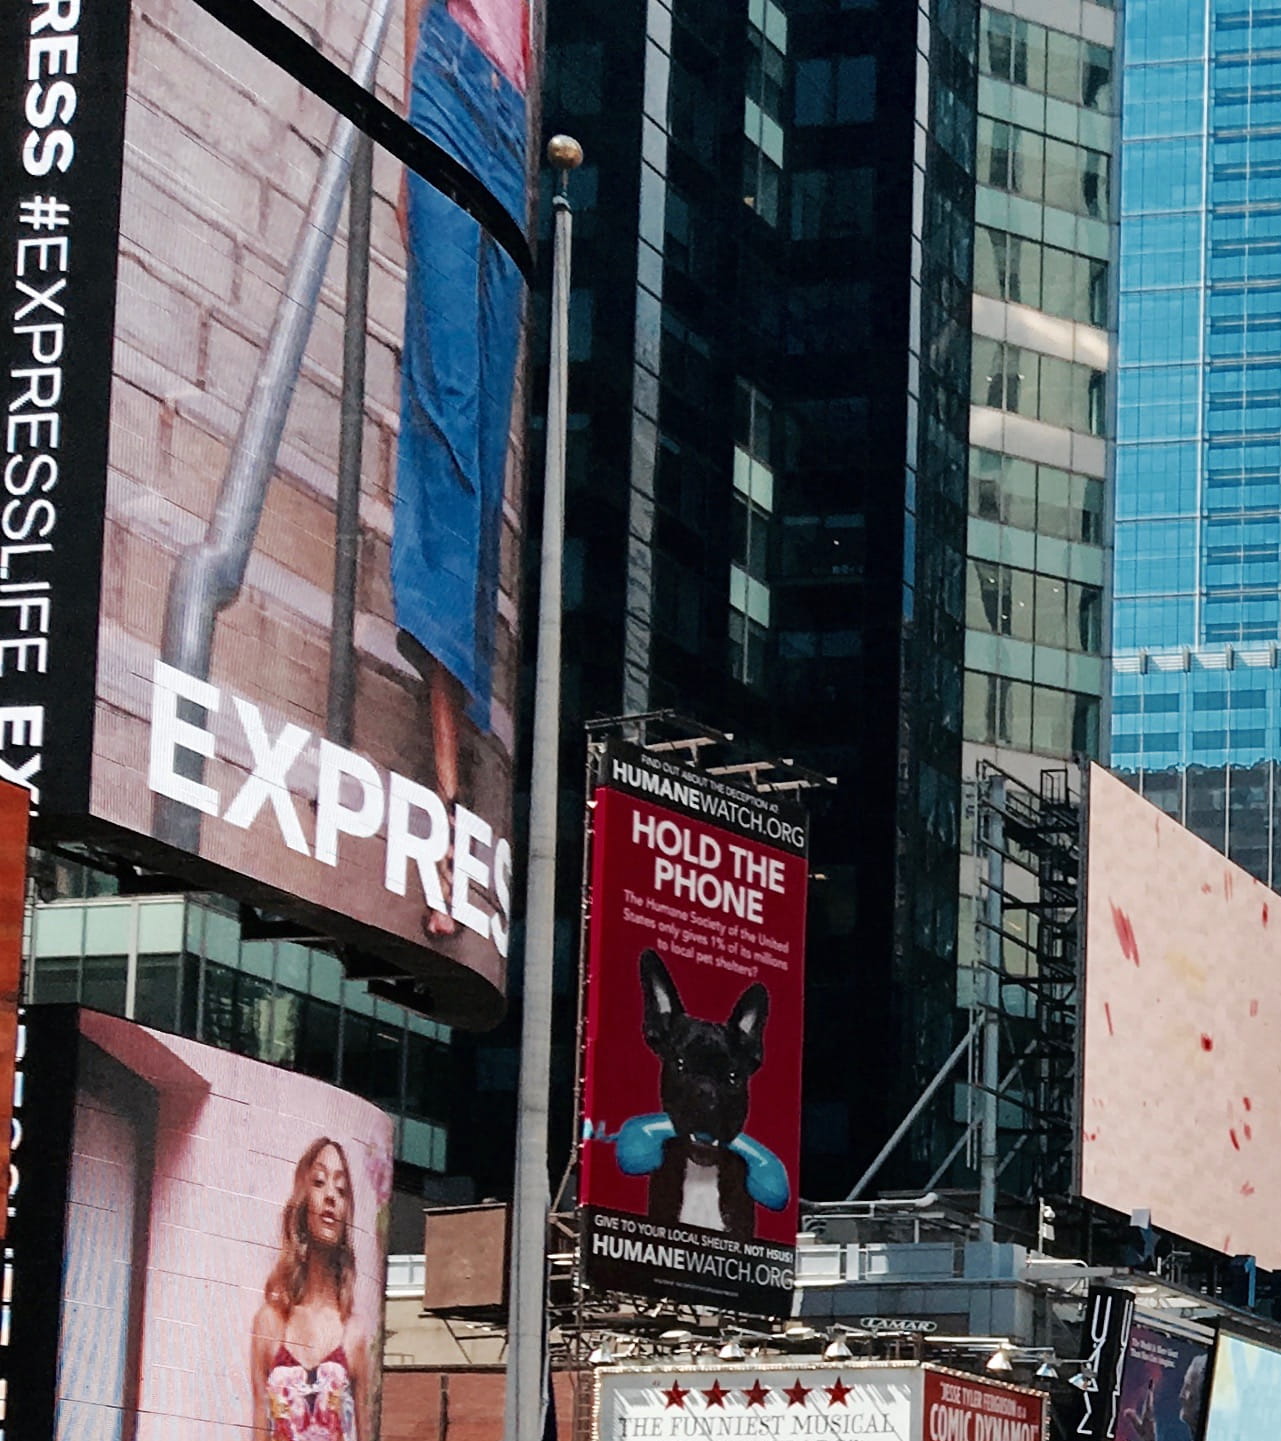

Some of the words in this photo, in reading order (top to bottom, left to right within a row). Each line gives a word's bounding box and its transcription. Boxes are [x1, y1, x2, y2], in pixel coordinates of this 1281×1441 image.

[612, 759, 805, 848] HUMANEWATCH.ORG
[632, 810, 721, 869] HOLD
[728, 843, 785, 894] THE
[654, 856, 764, 925] PHONE
[623, 889, 643, 907] The
[646, 898, 688, 923] Humane
[690, 910, 726, 937] Society
[728, 919, 740, 936] of
[758, 931, 790, 954] United
[623, 908, 656, 931] States
[658, 918, 681, 941] only
[682, 929, 708, 947] gives
[754, 947, 788, 971] millions
[657, 938, 668, 951] to
[671, 941, 695, 959] local
[696, 949, 714, 967] pet
[592, 1233, 794, 1291] HUMANEWATCH.ORG
[595, 1215, 619, 1230] GIVE
[621, 1218, 637, 1234] TO
[638, 1222, 667, 1239] YOUR
[667, 1227, 700, 1246] LOCAL
[743, 1243, 765, 1257] NOT
[864, 1318, 931, 1332] LAMAR
[670, 1416, 785, 1437] FUNNIEST
[790, 1413, 895, 1436] MUSICAL
